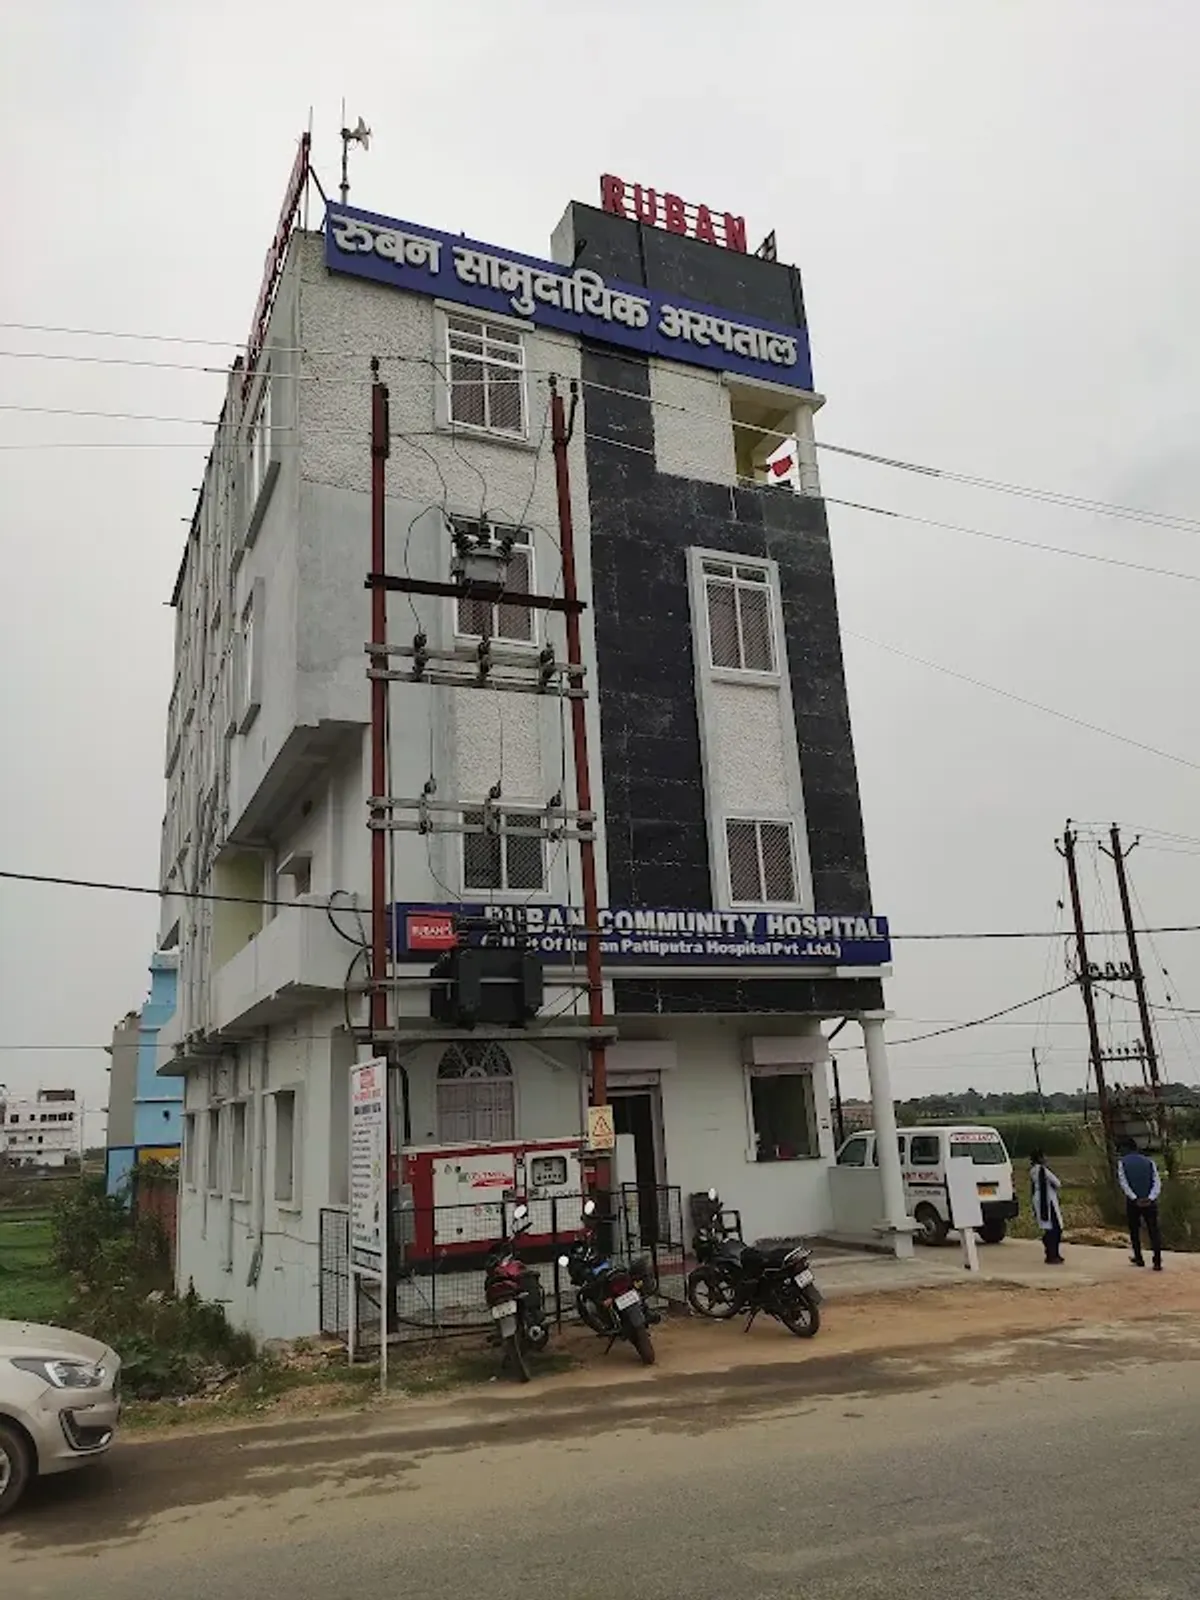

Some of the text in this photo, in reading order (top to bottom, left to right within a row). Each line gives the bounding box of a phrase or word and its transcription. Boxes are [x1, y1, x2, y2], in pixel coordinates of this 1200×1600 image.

[600, 173, 747, 254] RUBAN
[331, 214, 797, 366] रुबन सामुदायिक अस्पताल
[541, 936, 563, 951] Of
[565, 937, 619, 954] Ruan
[621, 939, 704, 957] Patliputra
[706, 940, 771, 957] Hospital
[772, 941, 799, 955] Pvt
[598, 910, 757, 938] COMMUNITY
[765, 914, 885, 941] HOSPITAL
